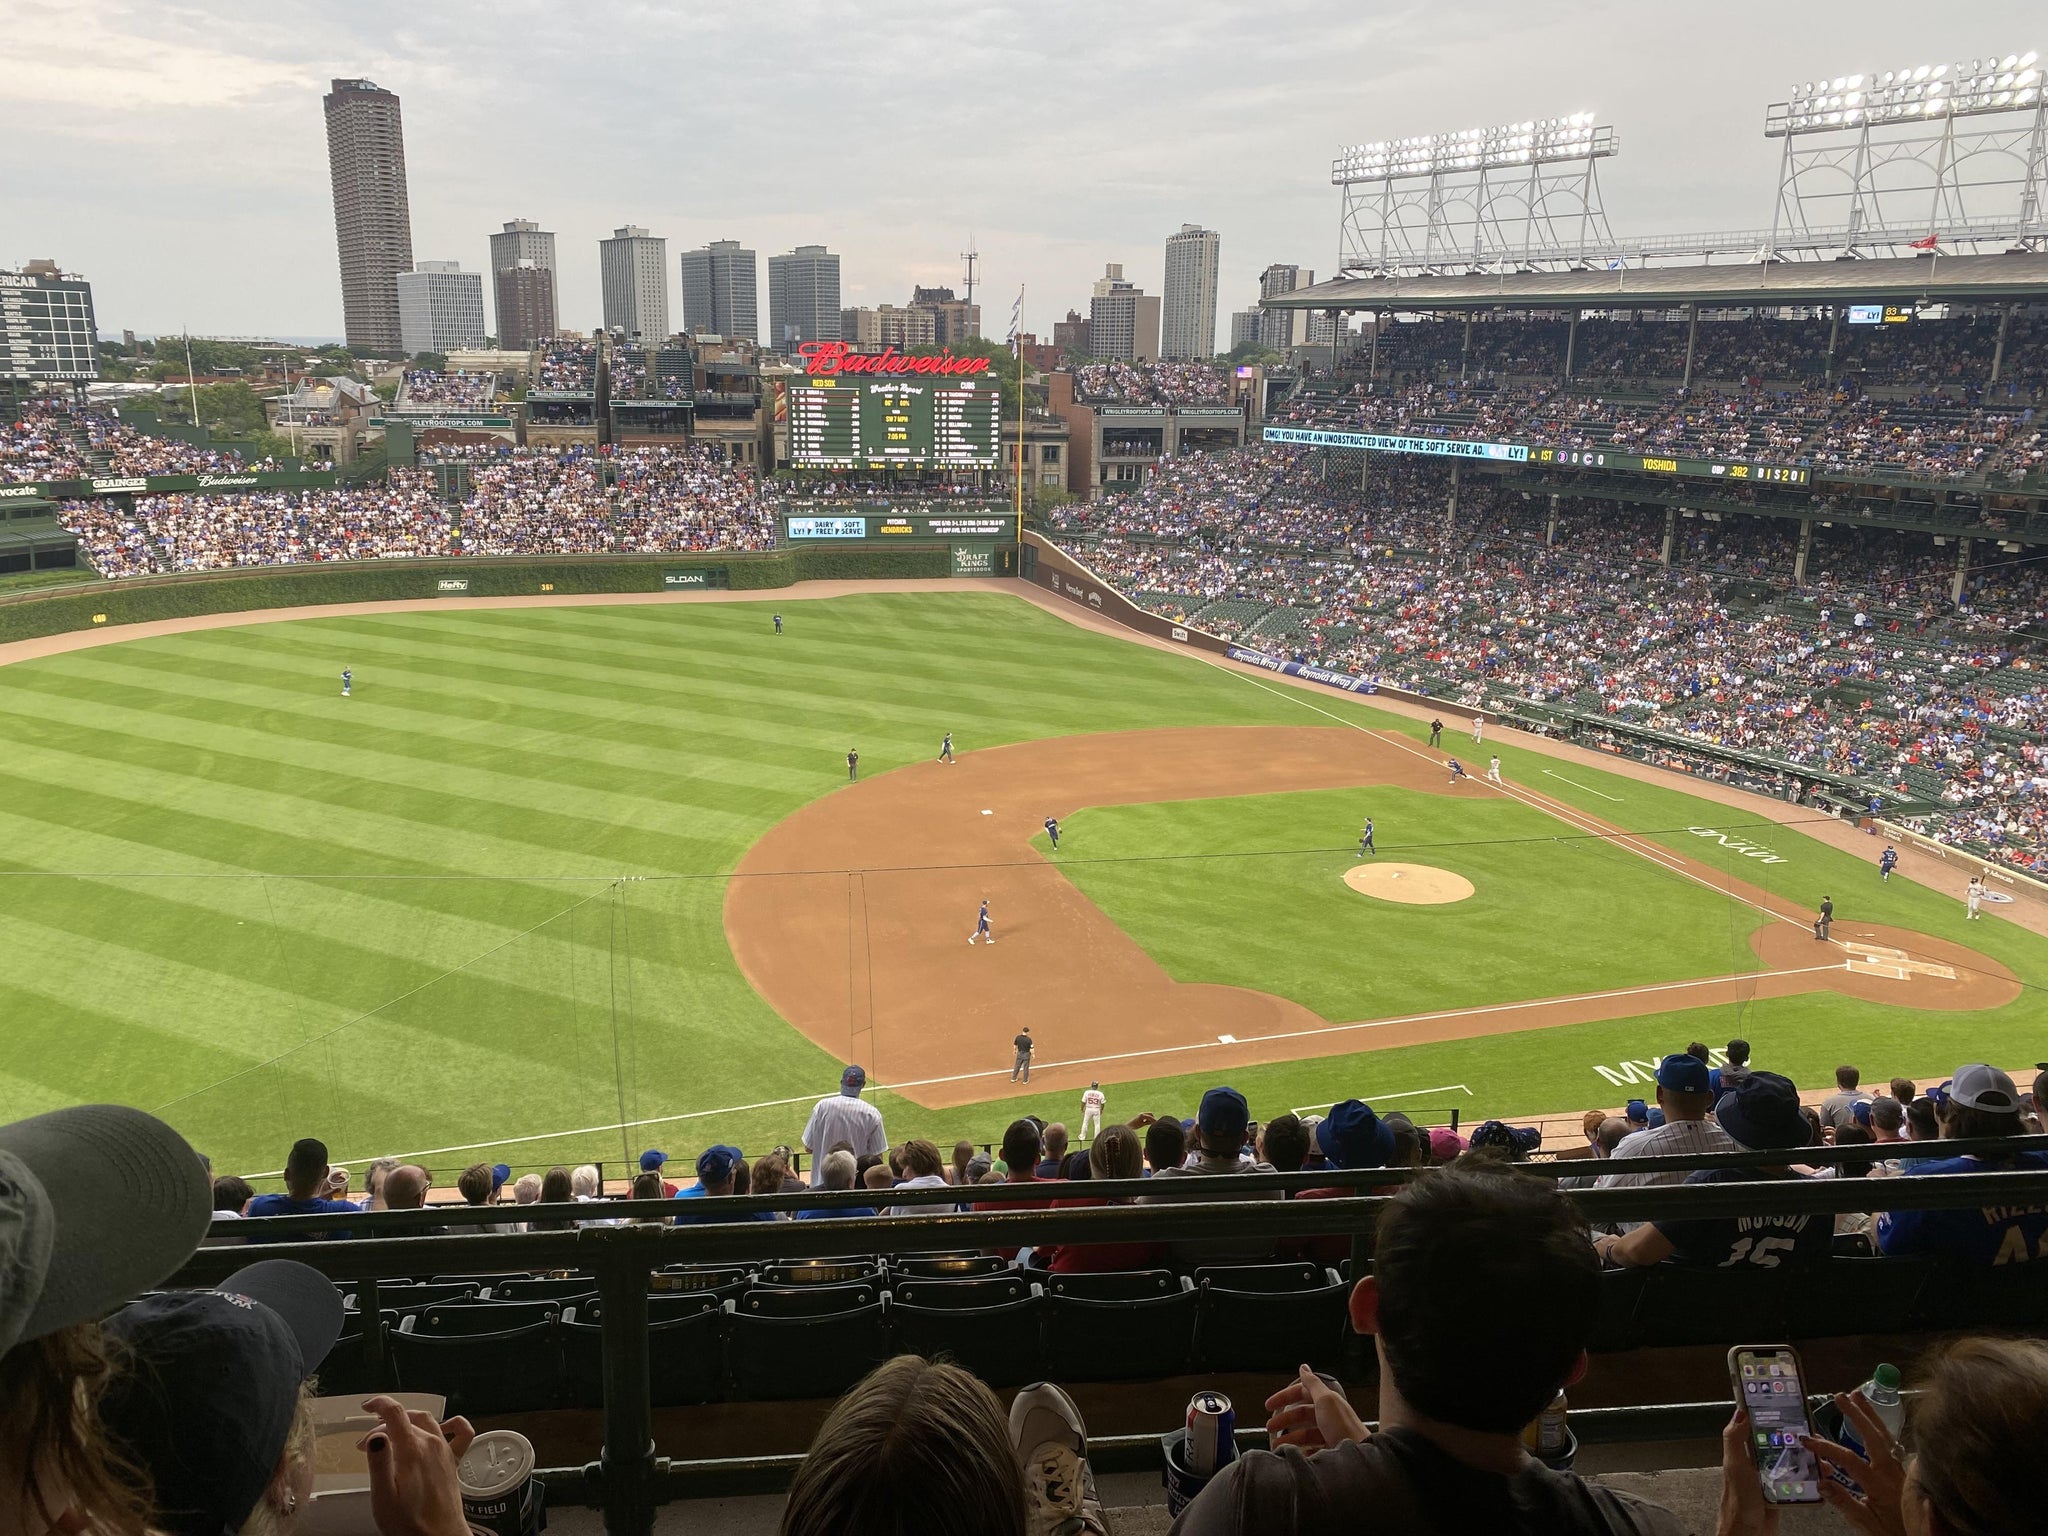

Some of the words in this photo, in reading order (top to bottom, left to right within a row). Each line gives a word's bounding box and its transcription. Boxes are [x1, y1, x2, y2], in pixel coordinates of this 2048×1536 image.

[798, 341, 990, 375] Budweiser
[870, 383, 898, 394] Weather
[900, 383, 924, 394] Report
[960, 382, 975, 390] CUBS
[1265, 430, 1280, 440] OMG!
[1282, 431, 1294, 441] YOU
[1296, 432, 1310, 442] HAVE
[1312, 433, 1322, 442] AN
[1324, 434, 1376, 447] UNOBSTRUCTED
[1378, 437, 1396, 448] VIEW
[1399, 439, 1409, 449] OF
[1410, 440, 1424, 450] THE
[1426, 441, 1444, 452] SOFT
[1446, 443, 1470, 454] SERVE
[1472, 445, 1485, 455] AD.
[1643, 458, 1677, 472] YOSHIDA
[1711, 465, 1725, 475] OBP
[1729, 466, 1748, 478] .382
[1758, 468, 1764, 478] B
[1774, 469, 1780, 479] S
[1782, 470, 1789, 480] 2
[92, 478, 146, 488] GRAINGER
[197, 476, 258, 486] Budweiser
[957, 554, 989, 562] DRAFT
[440, 580, 466, 590] Hefty
[1173, 630, 1186, 639] Swift
[1233, 650, 1260, 665] Reynolds
[1260, 657, 1278, 670] Wrap
[1297, 666, 1330, 681] Reynolds
[1330, 674, 1350, 688] Wrap
[478, 1502, 506, 1514] FIELD
